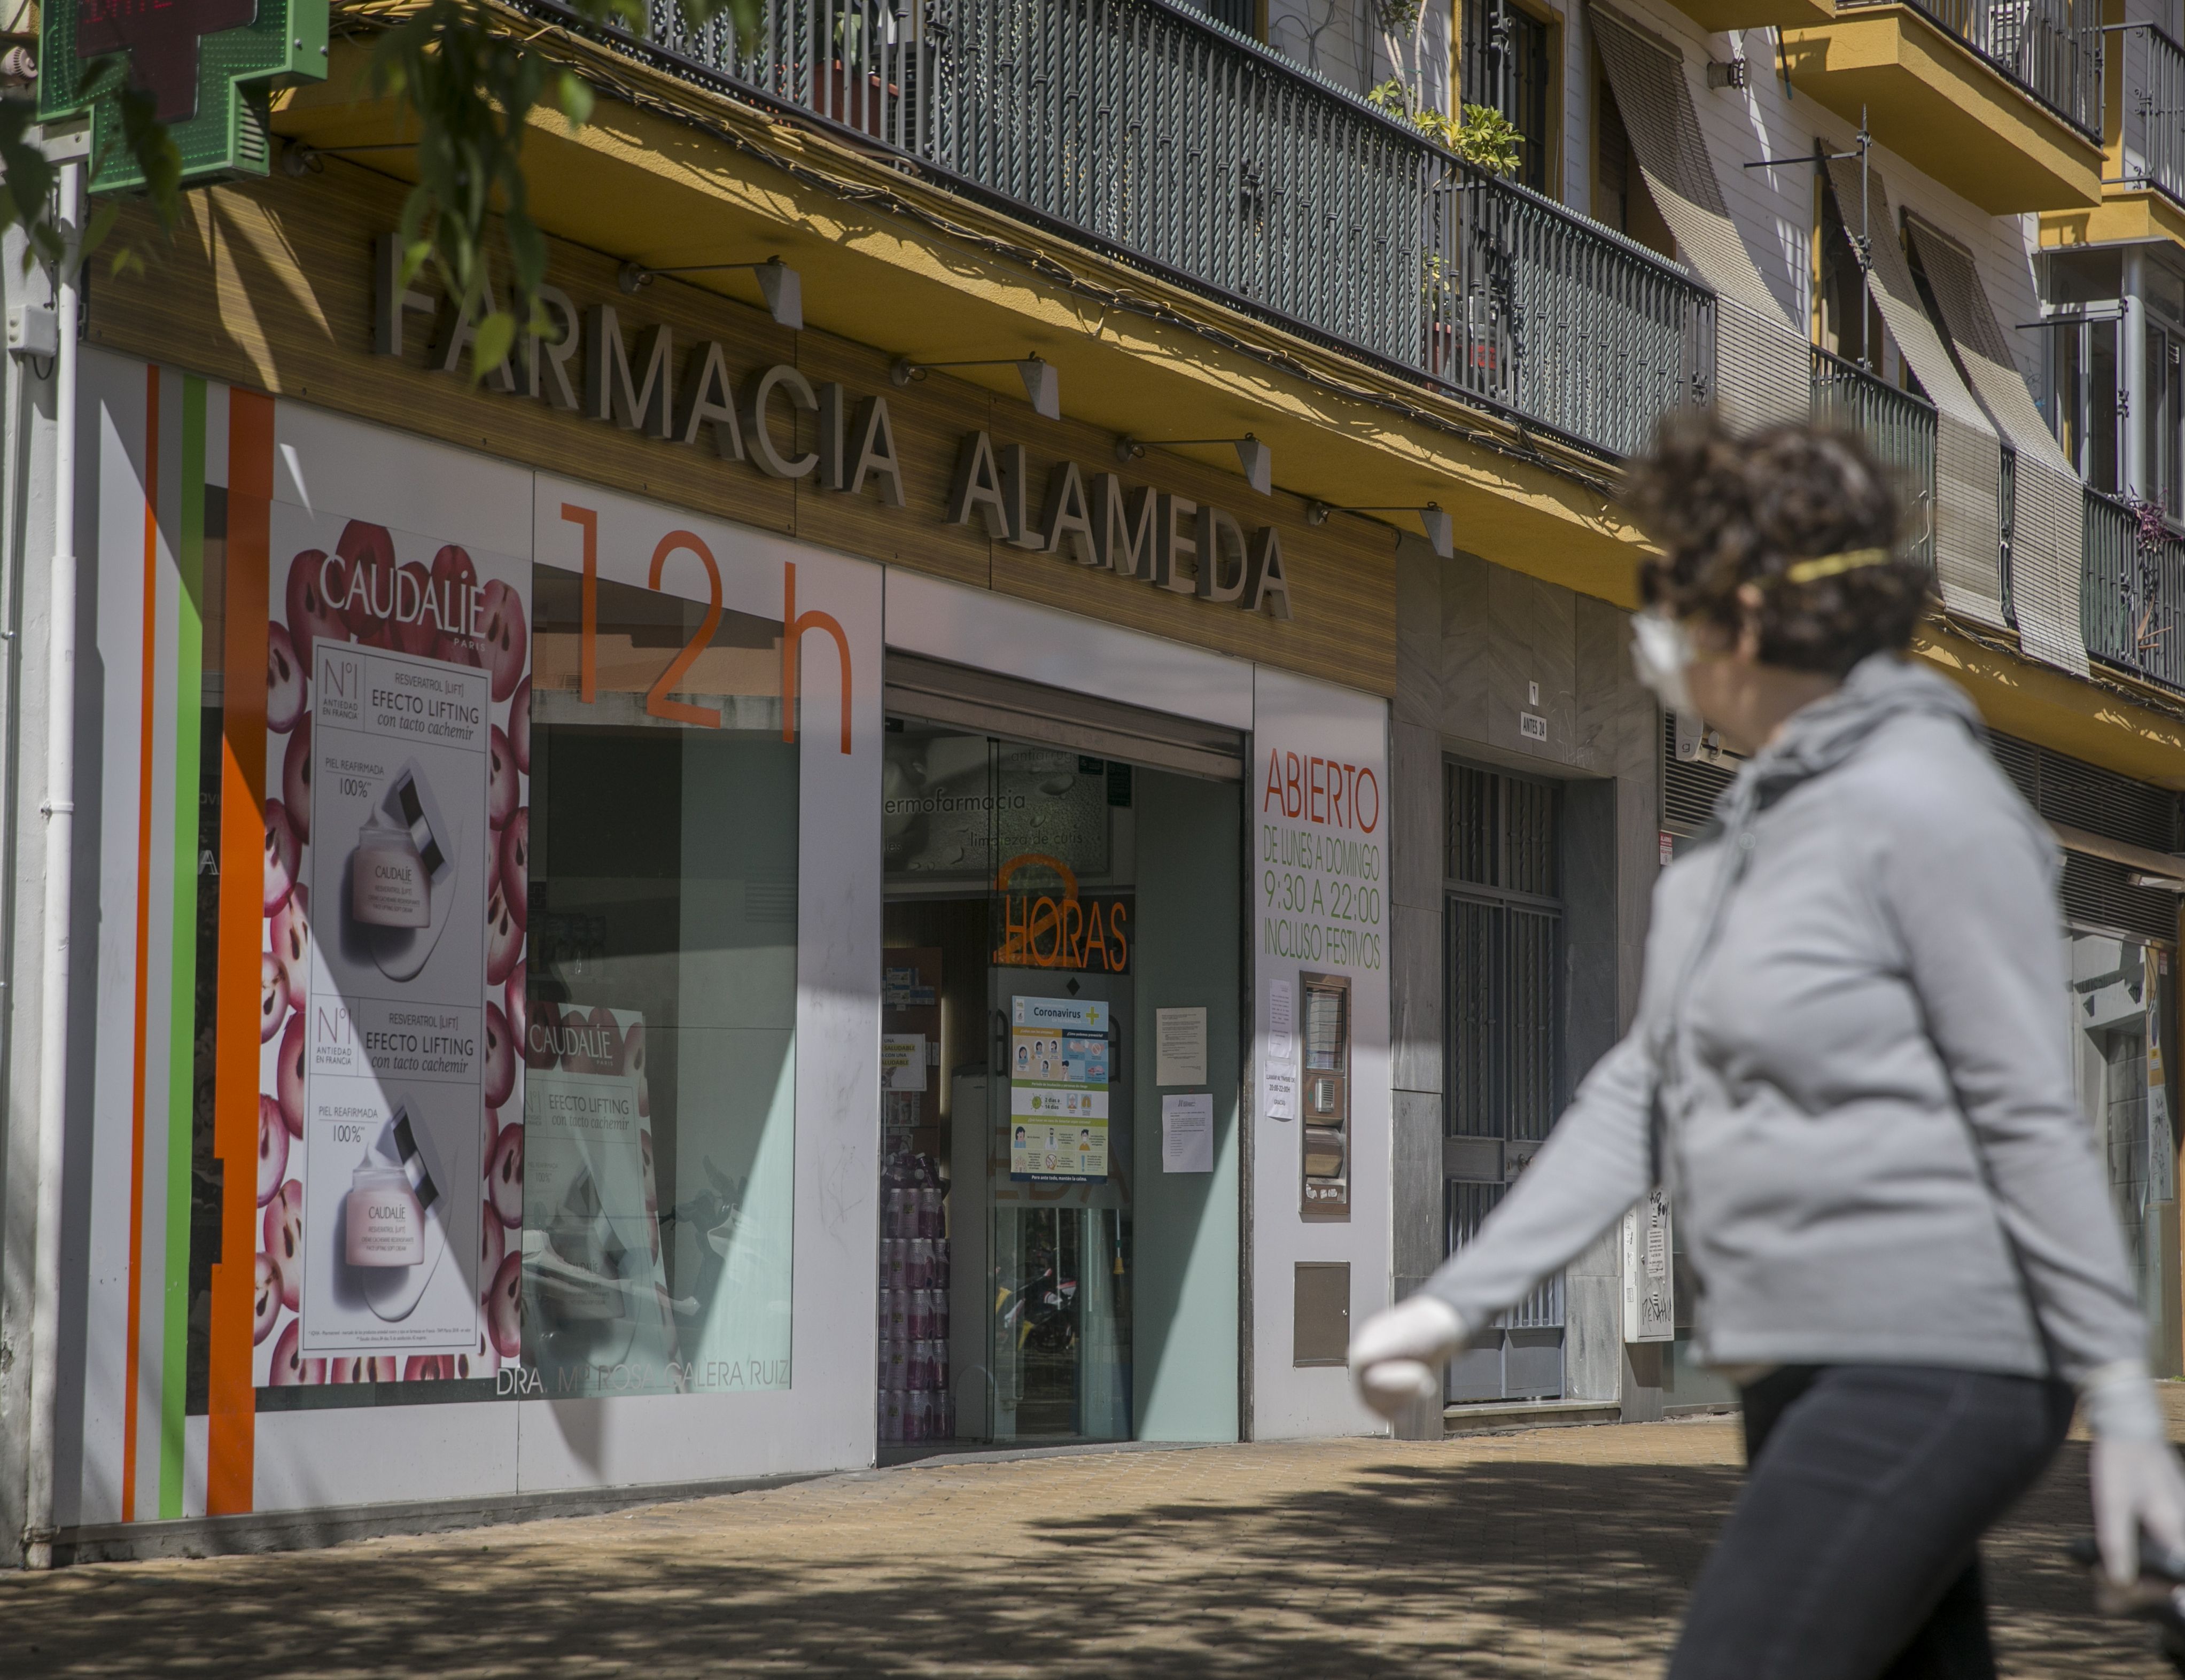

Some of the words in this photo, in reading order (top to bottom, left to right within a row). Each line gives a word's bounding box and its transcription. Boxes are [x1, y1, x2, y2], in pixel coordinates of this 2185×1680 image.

[376, 233, 905, 507] FARMACIA
[947, 431, 1294, 620] ALAMEDA
[454, 638, 485, 651] PARIS
[395, 673, 442, 693] RESVERATROL
[323, 698, 357, 711] ANTIEDAD
[372, 689, 423, 714] EFECTO
[429, 699, 479, 725] LIFTING
[377, 714, 396, 727] con
[400, 716, 425, 732] tacto
[428, 722, 473, 741] cachemir
[1523, 717, 1537, 735] ANTES
[1539, 721, 1545, 737] 24
[325, 757, 339, 769] PIEL
[340, 760, 384, 775] REAFIRMADA
[1264, 748, 1379, 834] ABIERTO
[1033, 830, 1048, 844] de
[1264, 825, 1278, 864] DE
[1282, 828, 1312, 870] LUNES
[1316, 835, 1323, 872] A
[1326, 836, 1380, 881] DOMINGO
[1264, 870, 1305, 913] 9:30
[1311, 878, 1324, 916] A
[1331, 881, 1380, 924] 22:00
[1006, 895, 1126, 971] HORAS
[1265, 917, 1321, 961] INCLUSO
[1326, 927, 1380, 970] FESTIVOS
[389, 1013, 438, 1028] RESVERATROL
[1034, 1007, 1080, 1018] Coronavirus
[317, 1046, 352, 1056] ANTIEDAD
[366, 1032, 417, 1053] EFECTO
[423, 1036, 473, 1056] LIFTING
[371, 1056, 390, 1069] con
[394, 1056, 419, 1070] tacto
[422, 1057, 468, 1074] cachemir
[319, 1106, 332, 1116] PIEL
[335, 1107, 378, 1118] REAFIRMADA
[549, 1094, 586, 1112] EFECTO
[589, 1098, 629, 1115] LIFTING
[551, 1115, 566, 1126] con
[570, 1115, 589, 1127] tacto
[590, 1117, 629, 1130] cachemir
[496, 1367, 548, 1395] DRA.
[598, 1363, 656, 1391] ROSA
[664, 1360, 743, 1389] GALERA
[750, 1359, 789, 1386] RUIZ
